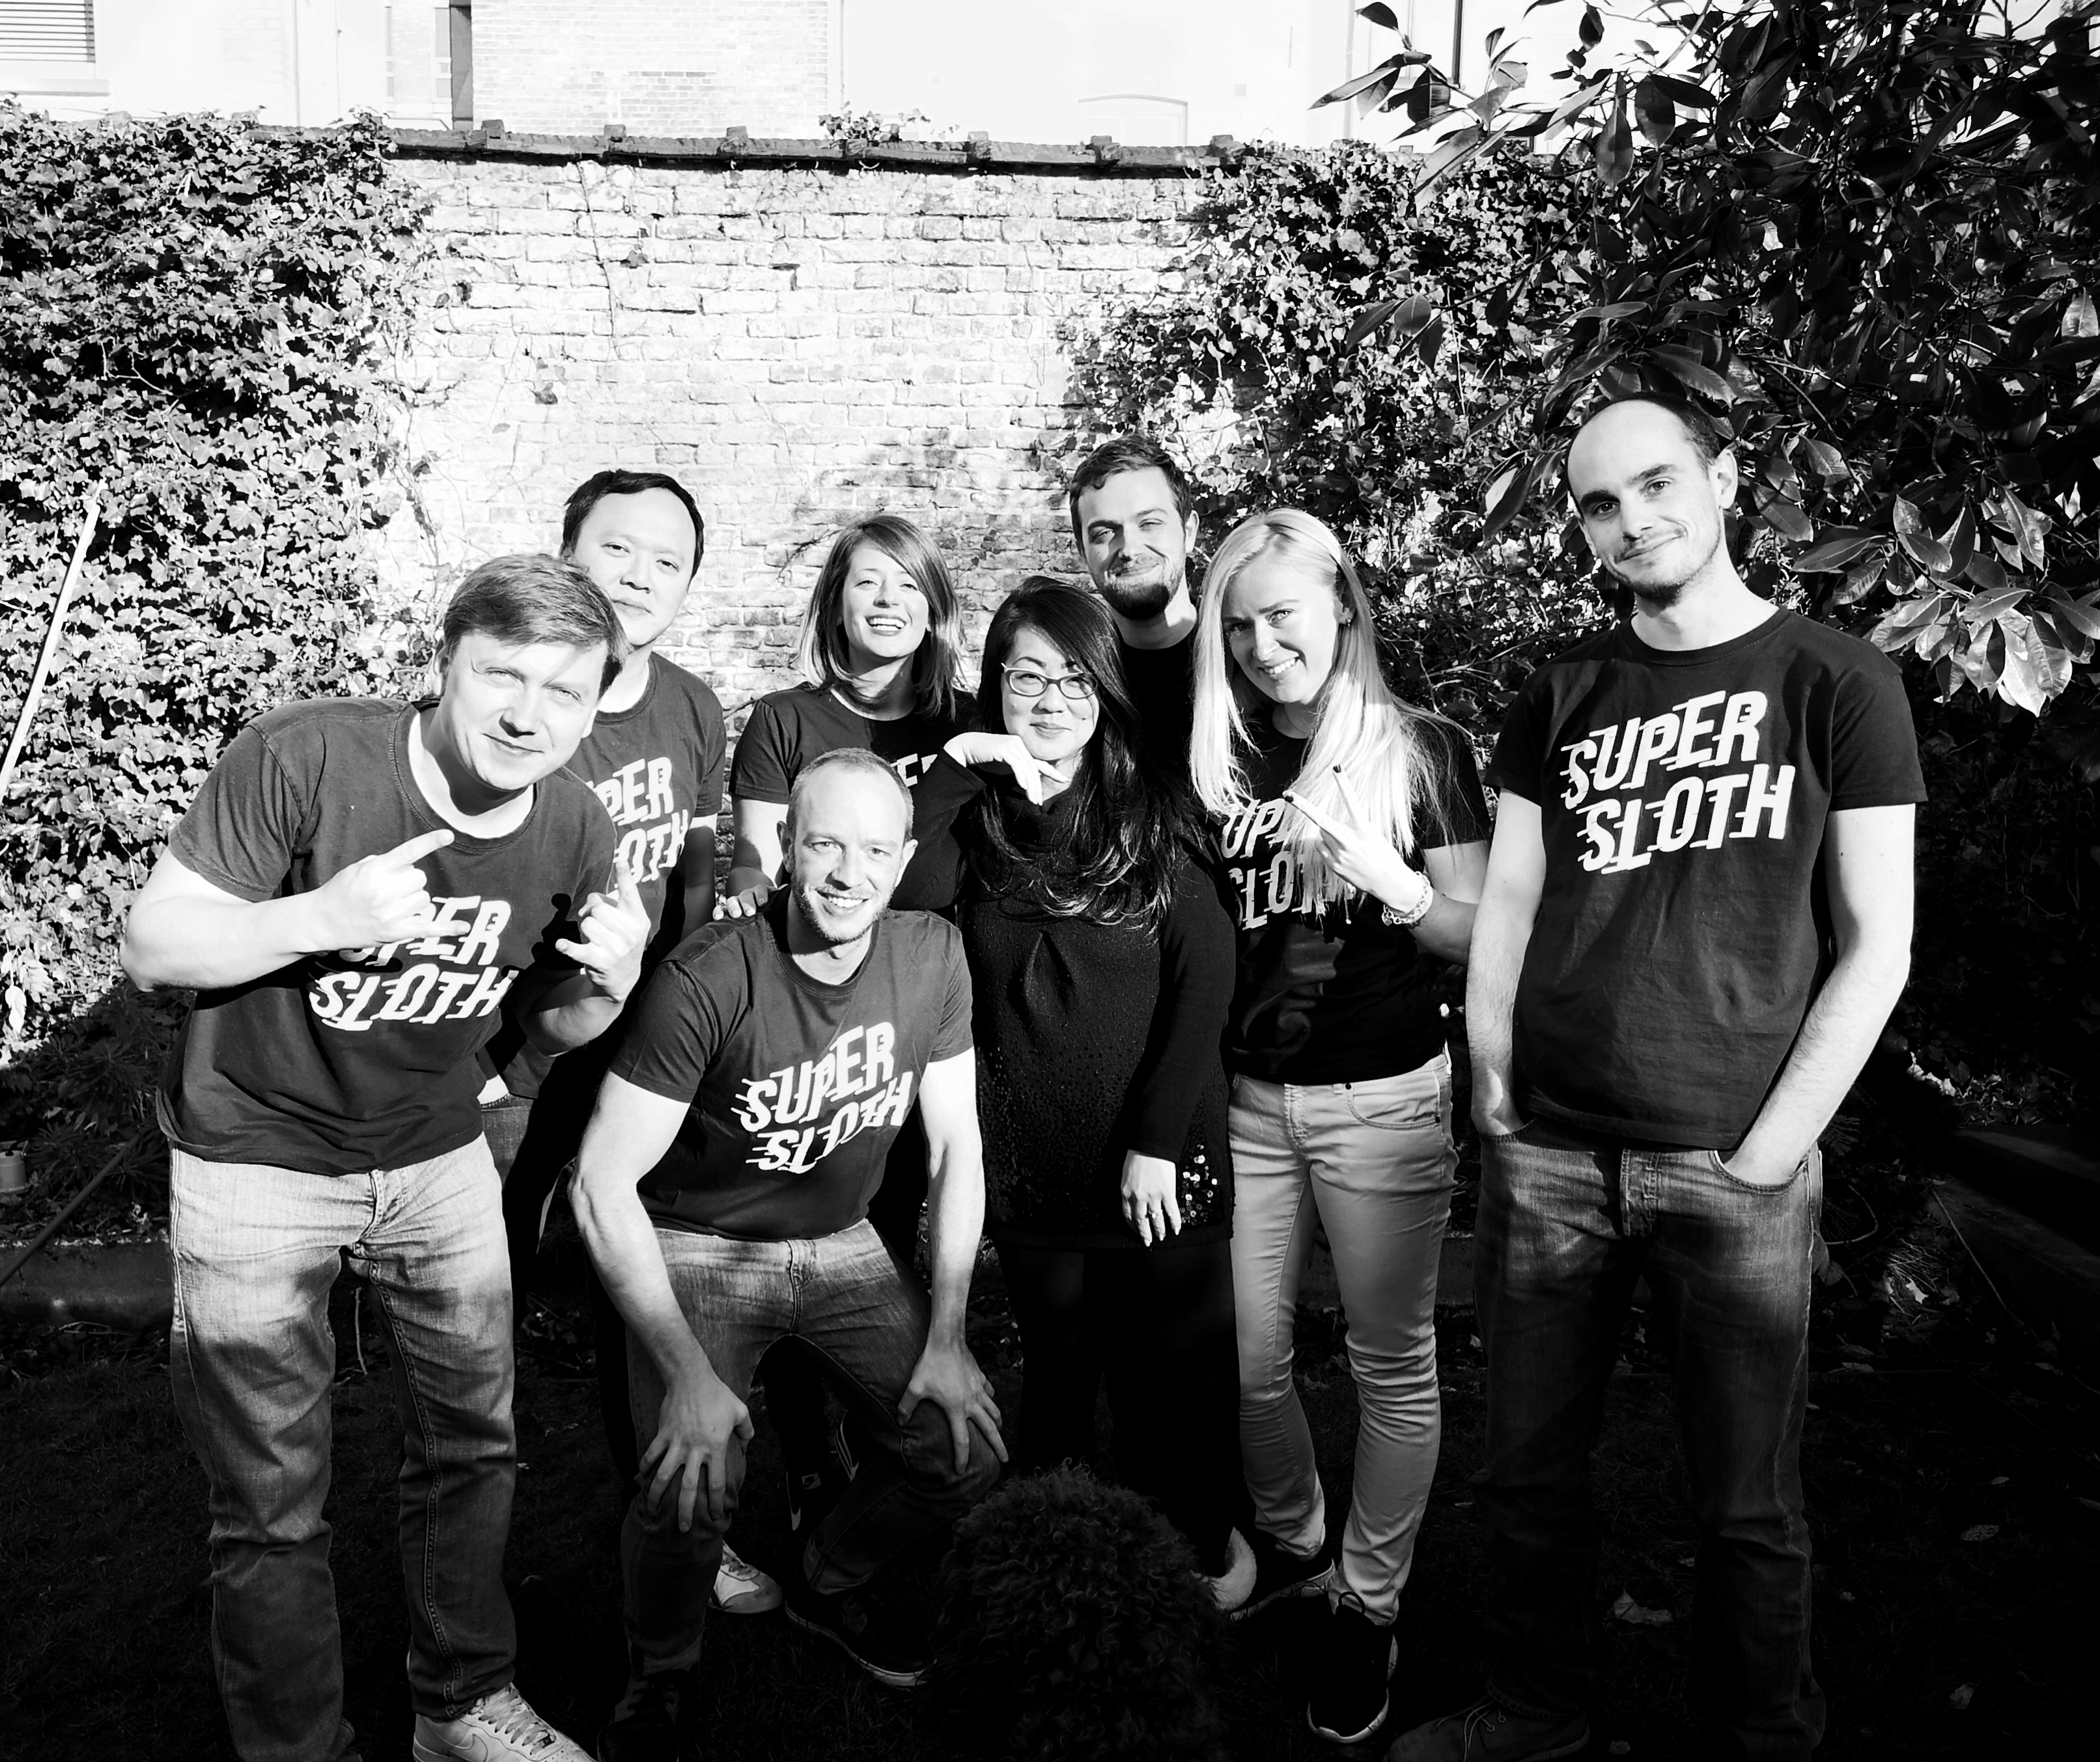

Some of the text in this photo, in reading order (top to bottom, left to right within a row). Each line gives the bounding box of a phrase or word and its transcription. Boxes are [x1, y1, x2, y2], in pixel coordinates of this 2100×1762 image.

[584, 756, 675, 826] PER
[1559, 690, 1768, 809] SUPER
[1575, 763, 1796, 874] SLOTH
[309, 962, 520, 1031] SLOTH
[730, 1021, 895, 1132] SUPER
[745, 1070, 914, 1174] SLOTH
